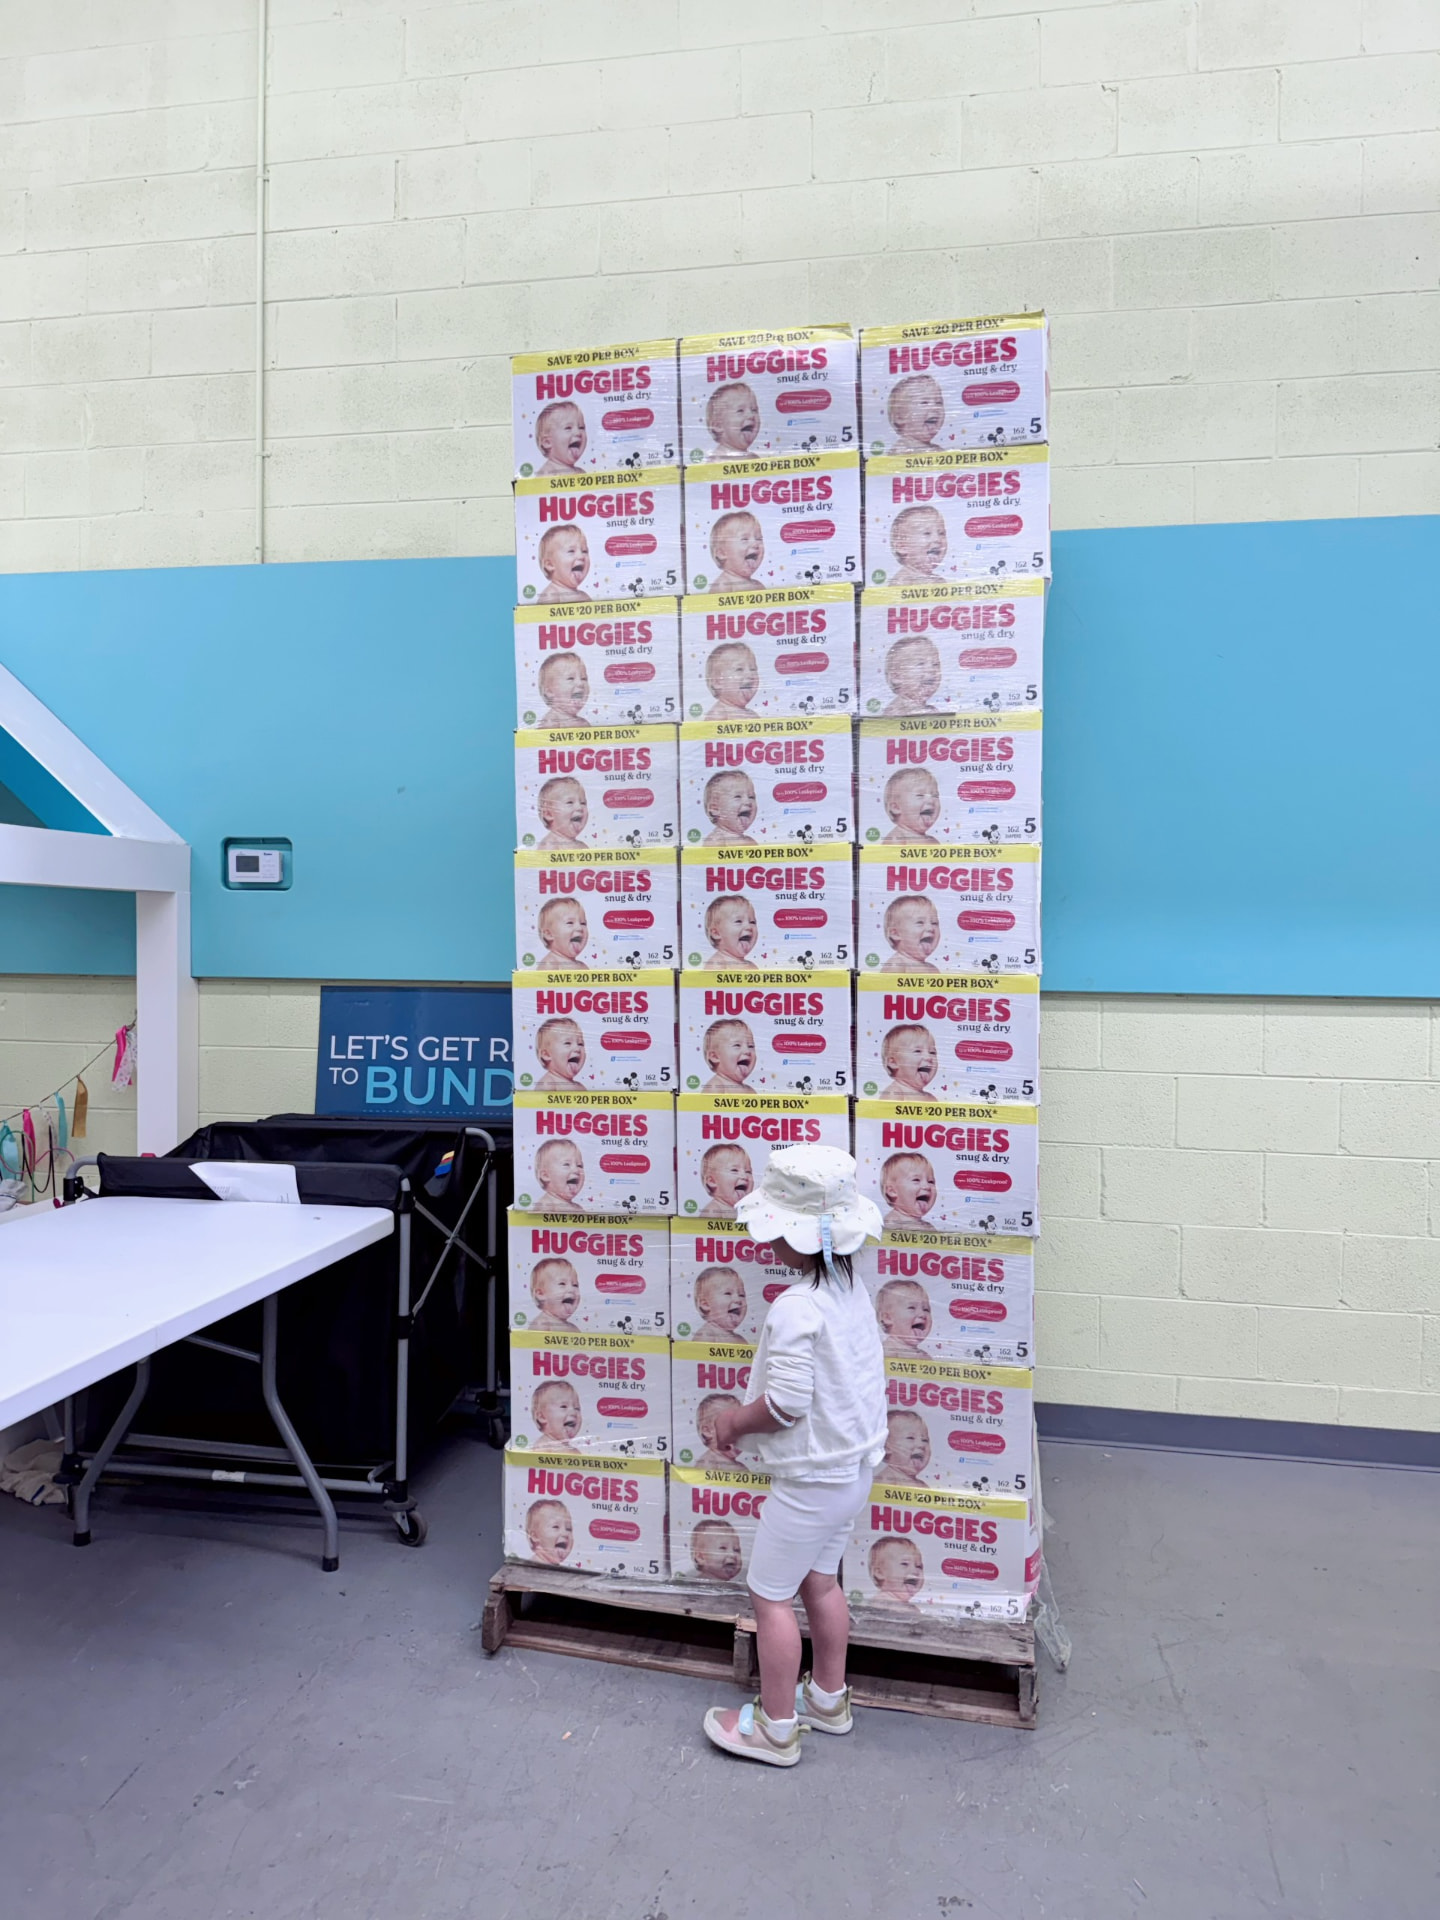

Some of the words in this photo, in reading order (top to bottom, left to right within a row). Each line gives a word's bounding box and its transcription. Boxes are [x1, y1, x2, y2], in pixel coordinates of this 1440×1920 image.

[889, 336, 1017, 375] HUGGIES
[707, 346, 827, 382] HUGGIES
[964, 366, 988, 376] snug
[989, 365, 997, 373] &
[999, 363, 1017, 373] dry
[536, 365, 651, 400] HUGGIES
[842, 425, 854, 442] 5
[1030, 417, 1042, 434] 5
[663, 443, 674, 459] 5
[723, 464, 749, 475] SAVE
[770, 460, 791, 470] PER
[550, 478, 576, 489] SAVE
[595, 475, 615, 485] PER
[892, 470, 1021, 504] HUGGIES
[711, 475, 833, 510] HUGGIES
[539, 491, 655, 523] HUGGIES
[782, 504, 805, 514] snug
[806, 503, 813, 512] &
[816, 502, 833, 512] dry
[606, 518, 628, 528] snug
[630, 518, 636, 526] &
[638, 516, 655, 526] dry
[844, 555, 856, 572] 5
[1032, 551, 1044, 568] 5
[666, 569, 677, 585] 5
[706, 609, 827, 641] HUGGIES
[887, 603, 1016, 634] HUGGIES
[538, 620, 653, 650] HUGGIES
[838, 688, 849, 704] 5
[1025, 684, 1038, 700] 5
[664, 697, 675, 712] 5
[705, 739, 825, 768] HUGGIES
[886, 736, 1014, 765] HUGGIES
[538, 747, 652, 774] HUGGIES
[663, 823, 673, 838] 5
[836, 817, 847, 833] 5
[1024, 817, 1036, 833] 5
[550, 854, 575, 863] SAVE
[594, 852, 613, 861] PER
[718, 850, 744, 859] SAVE
[764, 848, 784, 858] PER
[539, 869, 652, 895] HUGGIES
[706, 866, 825, 892] HUGGIES
[886, 866, 1014, 892] HUGGIES
[605, 894, 626, 903] snug
[627, 894, 634, 902] &
[636, 893, 652, 903] dry
[775, 892, 798, 901] snug
[799, 892, 806, 900] &
[808, 891, 825, 901] dry
[663, 945, 673, 960] 5
[836, 944, 848, 960] 5
[1023, 949, 1036, 964] 5
[548, 974, 572, 983] SAVE
[591, 973, 610, 982] PER
[716, 974, 742, 983] SAVE
[763, 974, 783, 983] PER
[897, 978, 924, 987] SAVE
[946, 978, 968, 988] PER
[536, 990, 649, 1015] HUGGIES
[704, 990, 824, 1016] HUGGIES
[884, 994, 1011, 1023] HUGGIES
[774, 1018, 796, 1026] snug
[798, 1017, 805, 1025] &
[807, 1016, 824, 1027] dry
[958, 1024, 982, 1033] snug
[983, 1024, 990, 1032] &
[993, 1023, 1011, 1034] dry
[330, 1035, 408, 1061] LET'S
[418, 1036, 480, 1061] GET
[329, 1067, 359, 1085] TO
[660, 1067, 671, 1082] 5
[835, 1071, 846, 1086] 5
[1022, 1080, 1034, 1095] 5
[547, 1095, 572, 1104] SAVE
[591, 1095, 610, 1105] PER
[714, 1099, 740, 1108] SAVE
[760, 1099, 780, 1108] PER
[895, 1105, 923, 1116] SAVE
[945, 1107, 966, 1117] PER
[536, 1110, 648, 1137] HUGGIES
[702, 1115, 821, 1142] HUGGIES
[601, 1138, 623, 1147] snug
[624, 1138, 630, 1146] &
[632, 1138, 648, 1148] dry
[882, 1122, 1010, 1153] HUGGIES
[956, 1154, 980, 1163] snug
[982, 1154, 989, 1162] &
[992, 1154, 1010, 1164] dry
[659, 1191, 669, 1206] 5
[1021, 1211, 1033, 1227] 5
[531, 1229, 643, 1258] HUGGIES
[695, 1237, 782, 1265] HUGG
[597, 1258, 618, 1267] snug
[619, 1258, 626, 1266] &
[628, 1258, 643, 1268] dry
[878, 1249, 1005, 1283] HUGGIES
[654, 1311, 664, 1326] 5
[544, 1336, 569, 1345] SAVE
[588, 1338, 607, 1347] PER
[1016, 1342, 1028, 1358] 5
[533, 1351, 645, 1381] HUGGIES
[889, 1362, 917, 1373] SAVE
[939, 1366, 960, 1377] PER
[656, 1436, 667, 1451] 5
[527, 1468, 638, 1504] HUGGIES
[1014, 1474, 1026, 1490] 5
[870, 1505, 998, 1544] HUGGIES
[648, 1560, 658, 1576] 5
[1006, 1600, 1018, 1615] 5
